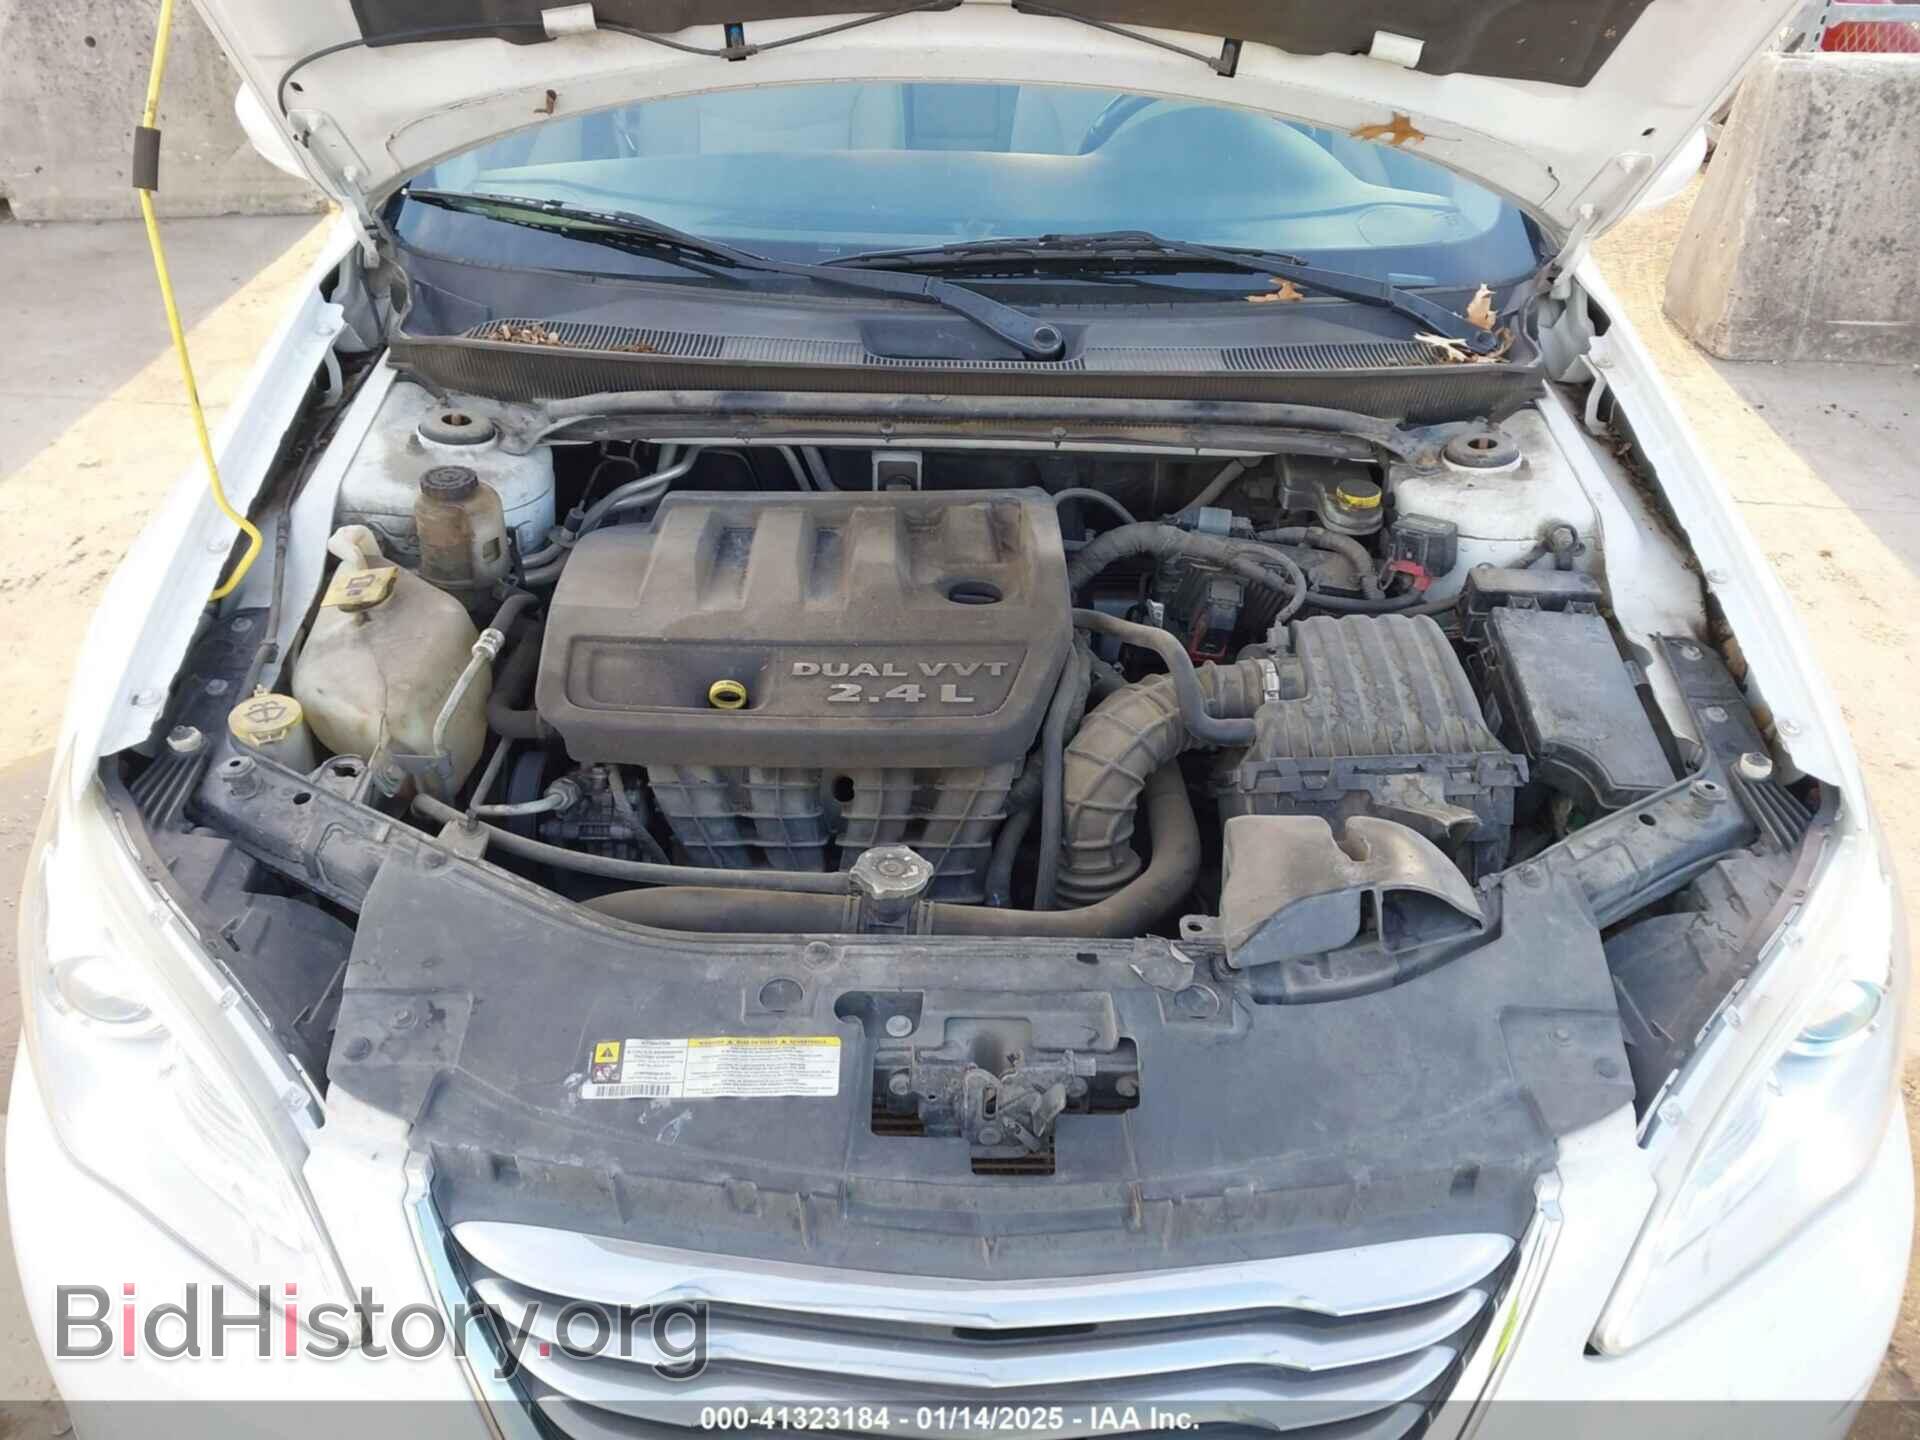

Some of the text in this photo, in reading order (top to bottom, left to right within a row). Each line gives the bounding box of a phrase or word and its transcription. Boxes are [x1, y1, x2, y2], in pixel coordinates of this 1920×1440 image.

[791, 661, 1009, 677] DUAL VVT
[827, 683, 975, 703] 2.4 L
